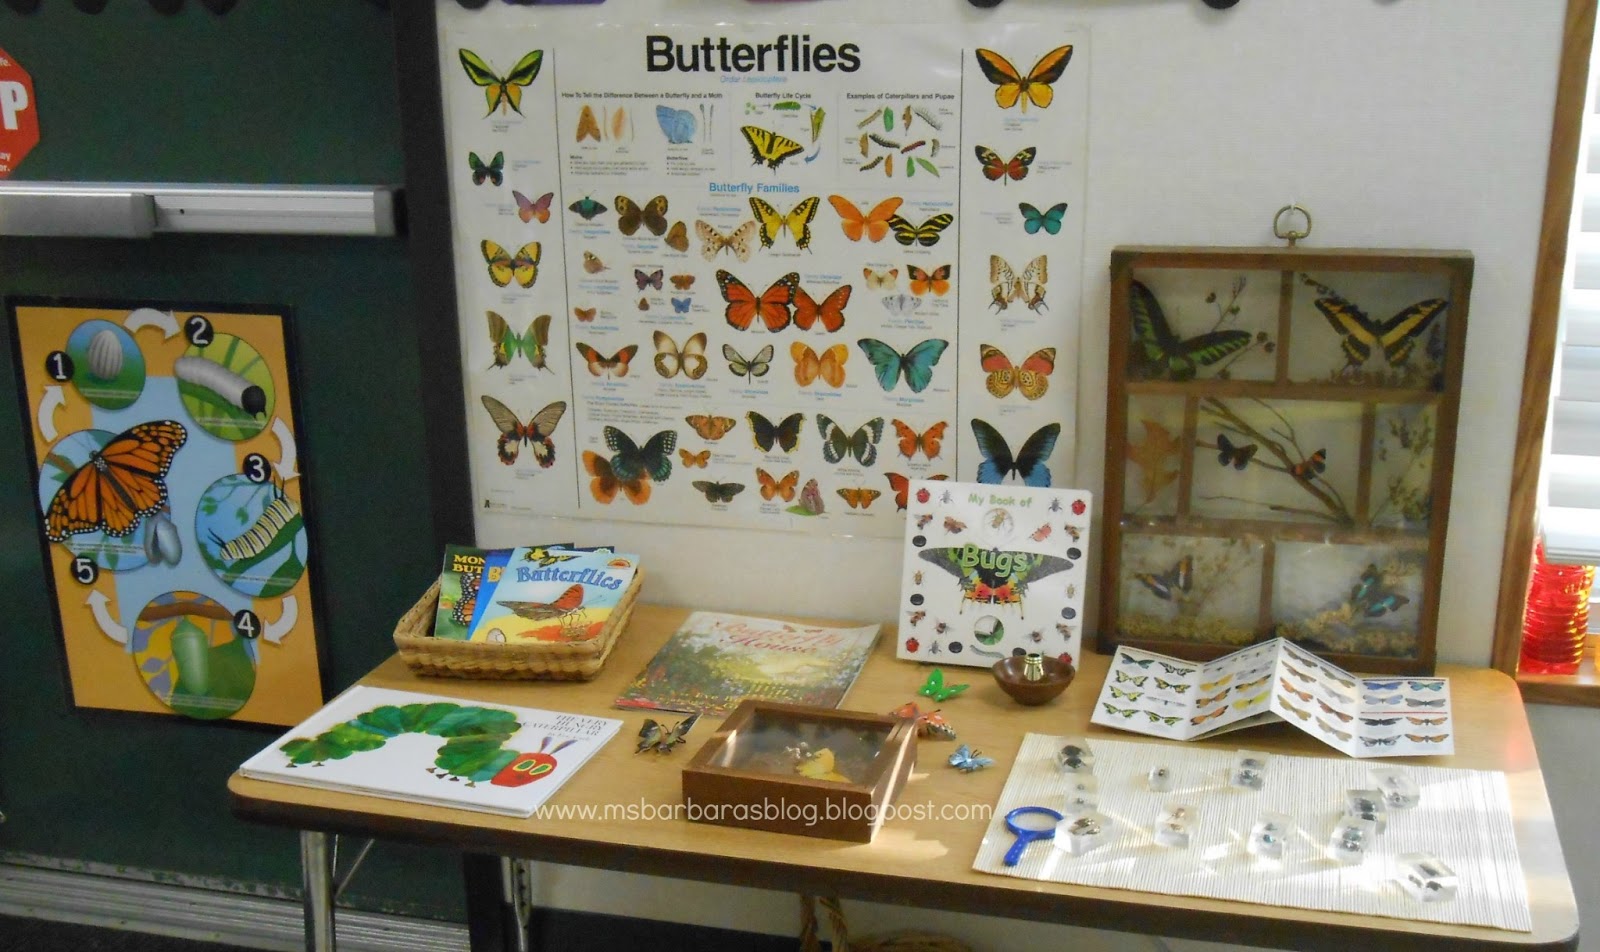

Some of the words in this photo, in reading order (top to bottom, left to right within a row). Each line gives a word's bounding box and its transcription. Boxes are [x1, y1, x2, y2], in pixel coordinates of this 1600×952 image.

[646, 35, 861, 73] Butterflies
[665, 92, 690, 100] Butterfly
[755, 92, 780, 100] Butterfly
[794, 92, 812, 100] Cycle
[846, 92, 875, 100] Examples
[884, 92, 919, 101] Caterpillars
[935, 93, 955, 101] Pupae
[709, 182, 753, 195] Butterfly
[756, 182, 800, 193] Families
[192, 317, 209, 345] 2
[54, 354, 66, 381] 1
[248, 455, 266, 482] 3
[968, 493, 985, 506] My
[989, 493, 1015, 507] Book
[1019, 494, 1033, 508] of
[75, 558, 94, 585] 5
[962, 543, 1028, 577] Bugs
[516, 566, 623, 590] Butterflies
[238, 612, 255, 638] 4
